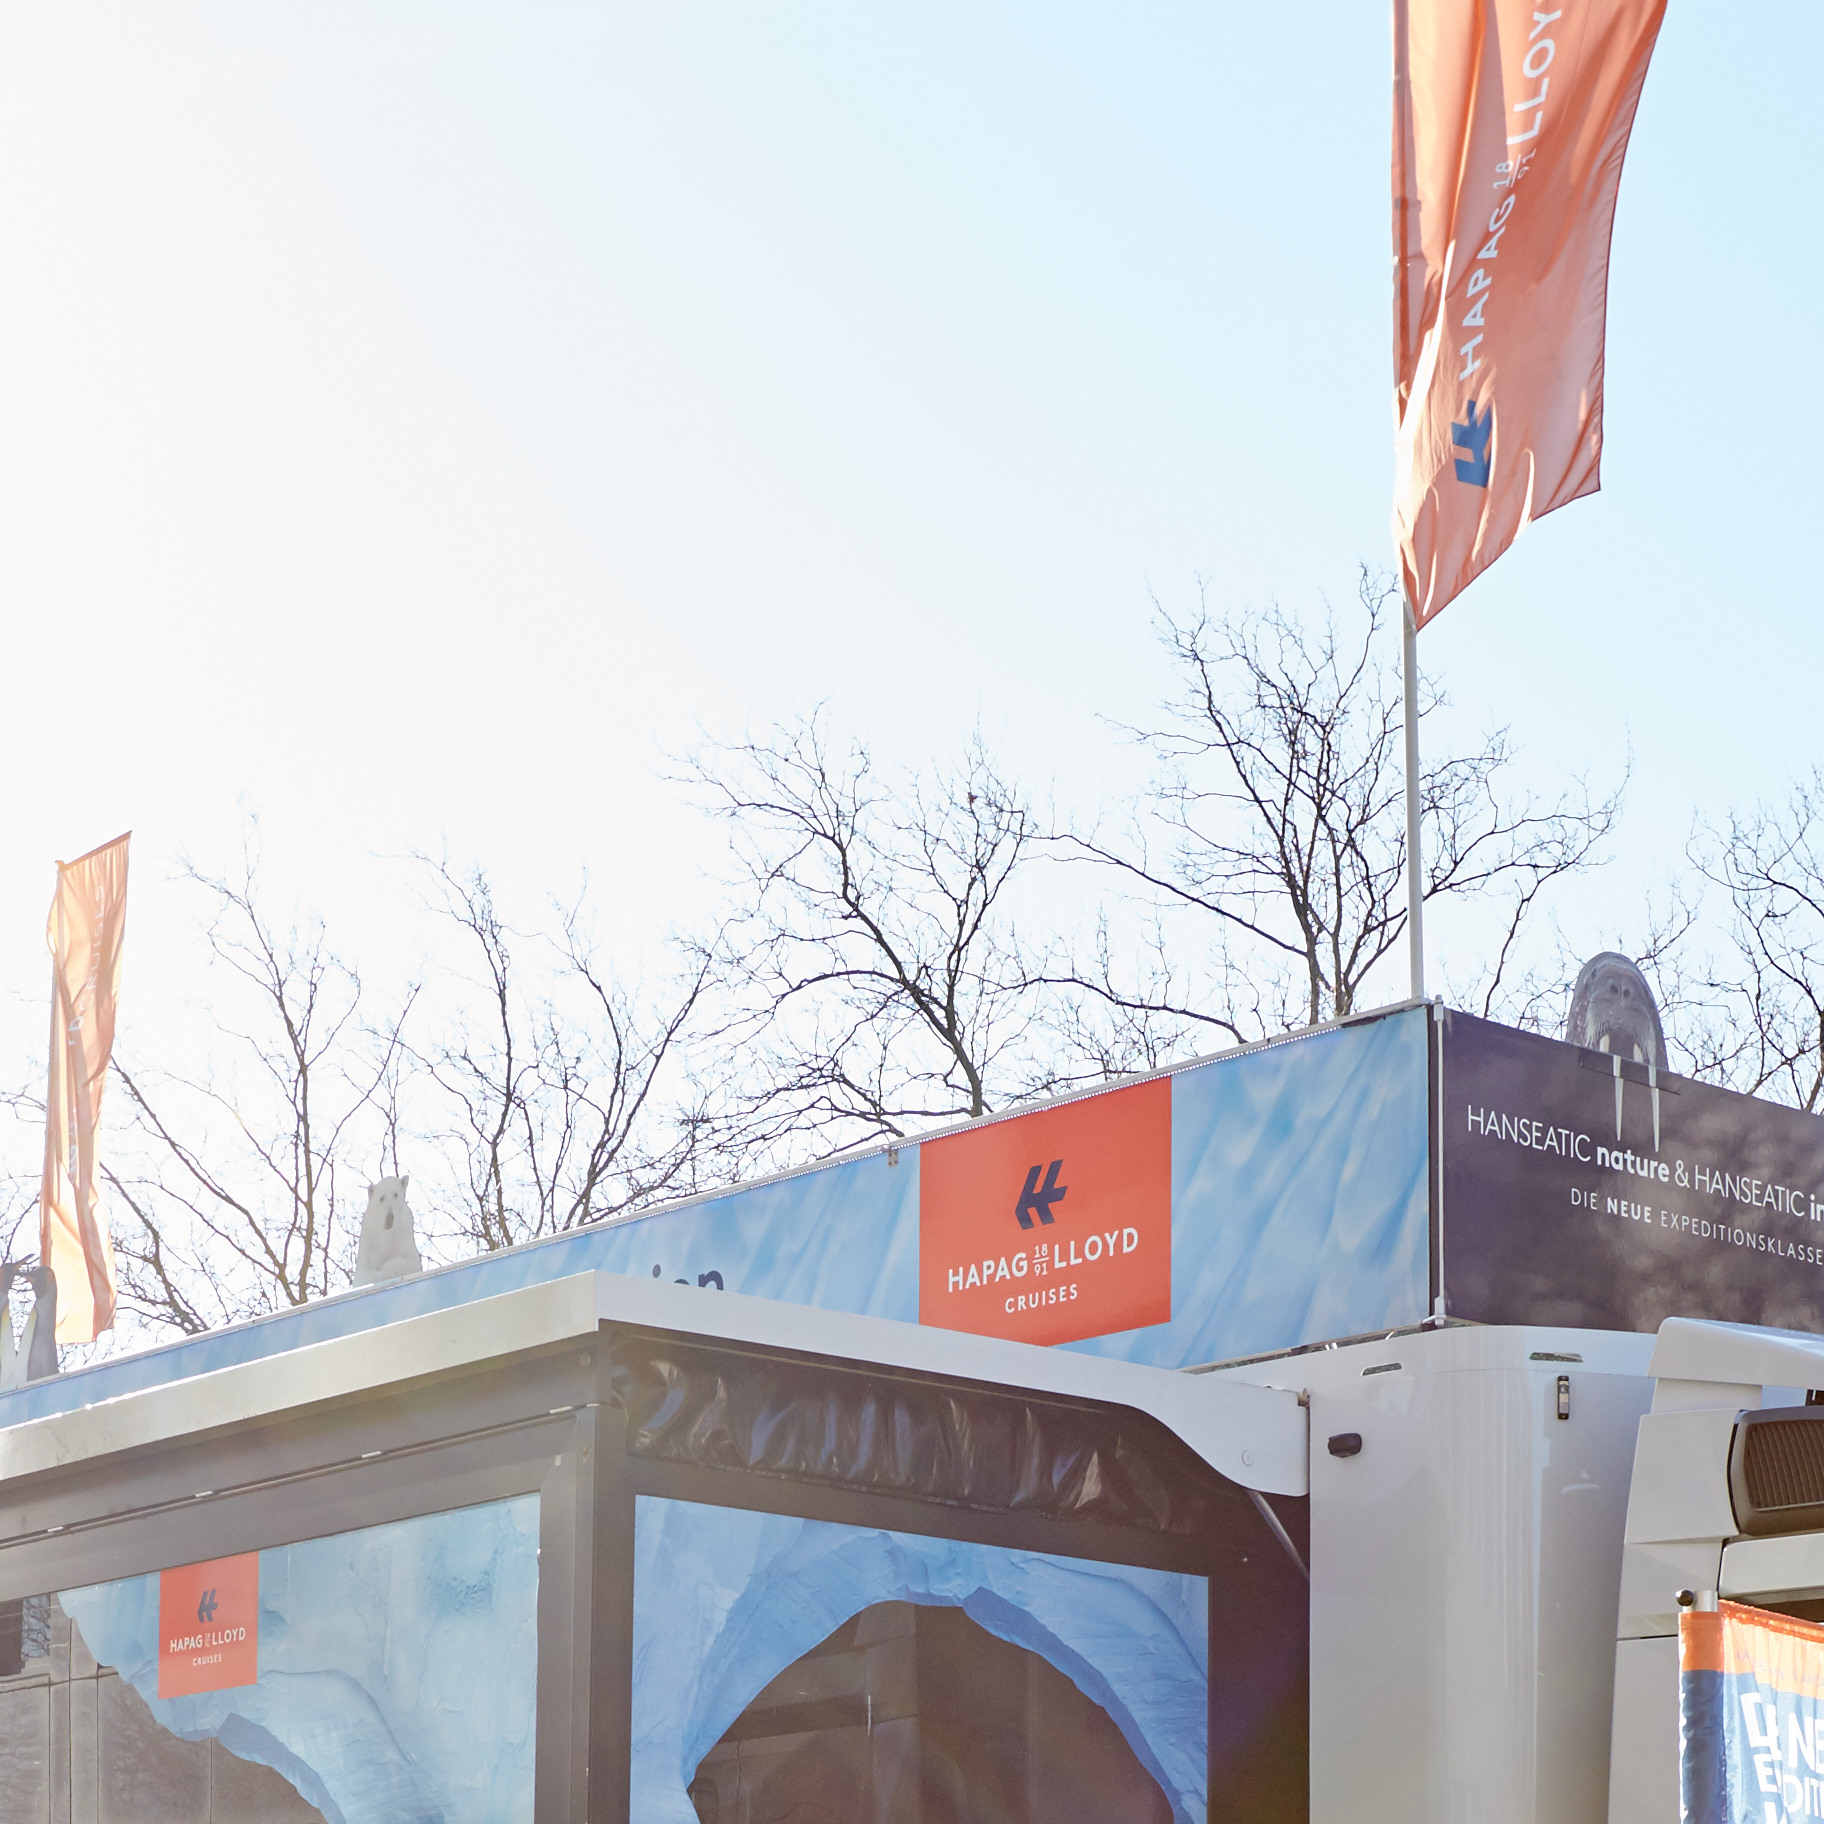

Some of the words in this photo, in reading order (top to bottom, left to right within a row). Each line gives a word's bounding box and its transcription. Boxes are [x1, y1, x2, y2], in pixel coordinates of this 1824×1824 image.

[1459, 194, 1516, 382] HAPAG
[1507, 9, 1562, 145] LLOY
[79, 886, 105, 1012] CRUISES
[1468, 1104, 1591, 1162] HANSEATIC
[1597, 1145, 1670, 1183] nature
[1675, 1159, 1690, 1188] &
[1694, 1164, 1805, 1217] HANSEATIC
[1571, 1188, 1598, 1210] DIE
[1607, 1197, 1652, 1223] NEUE
[1661, 1211, 1823, 1266] EXPEDITIONSKLASSE
[1034, 1244, 1048, 1258] 18
[1053, 1227, 1139, 1270] LLOYD
[948, 1252, 1028, 1293] HAPAG
[1034, 1263, 1048, 1277] 91
[1004, 1284, 1078, 1314] CRUISES
[169, 1634, 203, 1653] HAPAG
[212, 1627, 246, 1645] LLOYD
[192, 1653, 222, 1667] CRUISES
